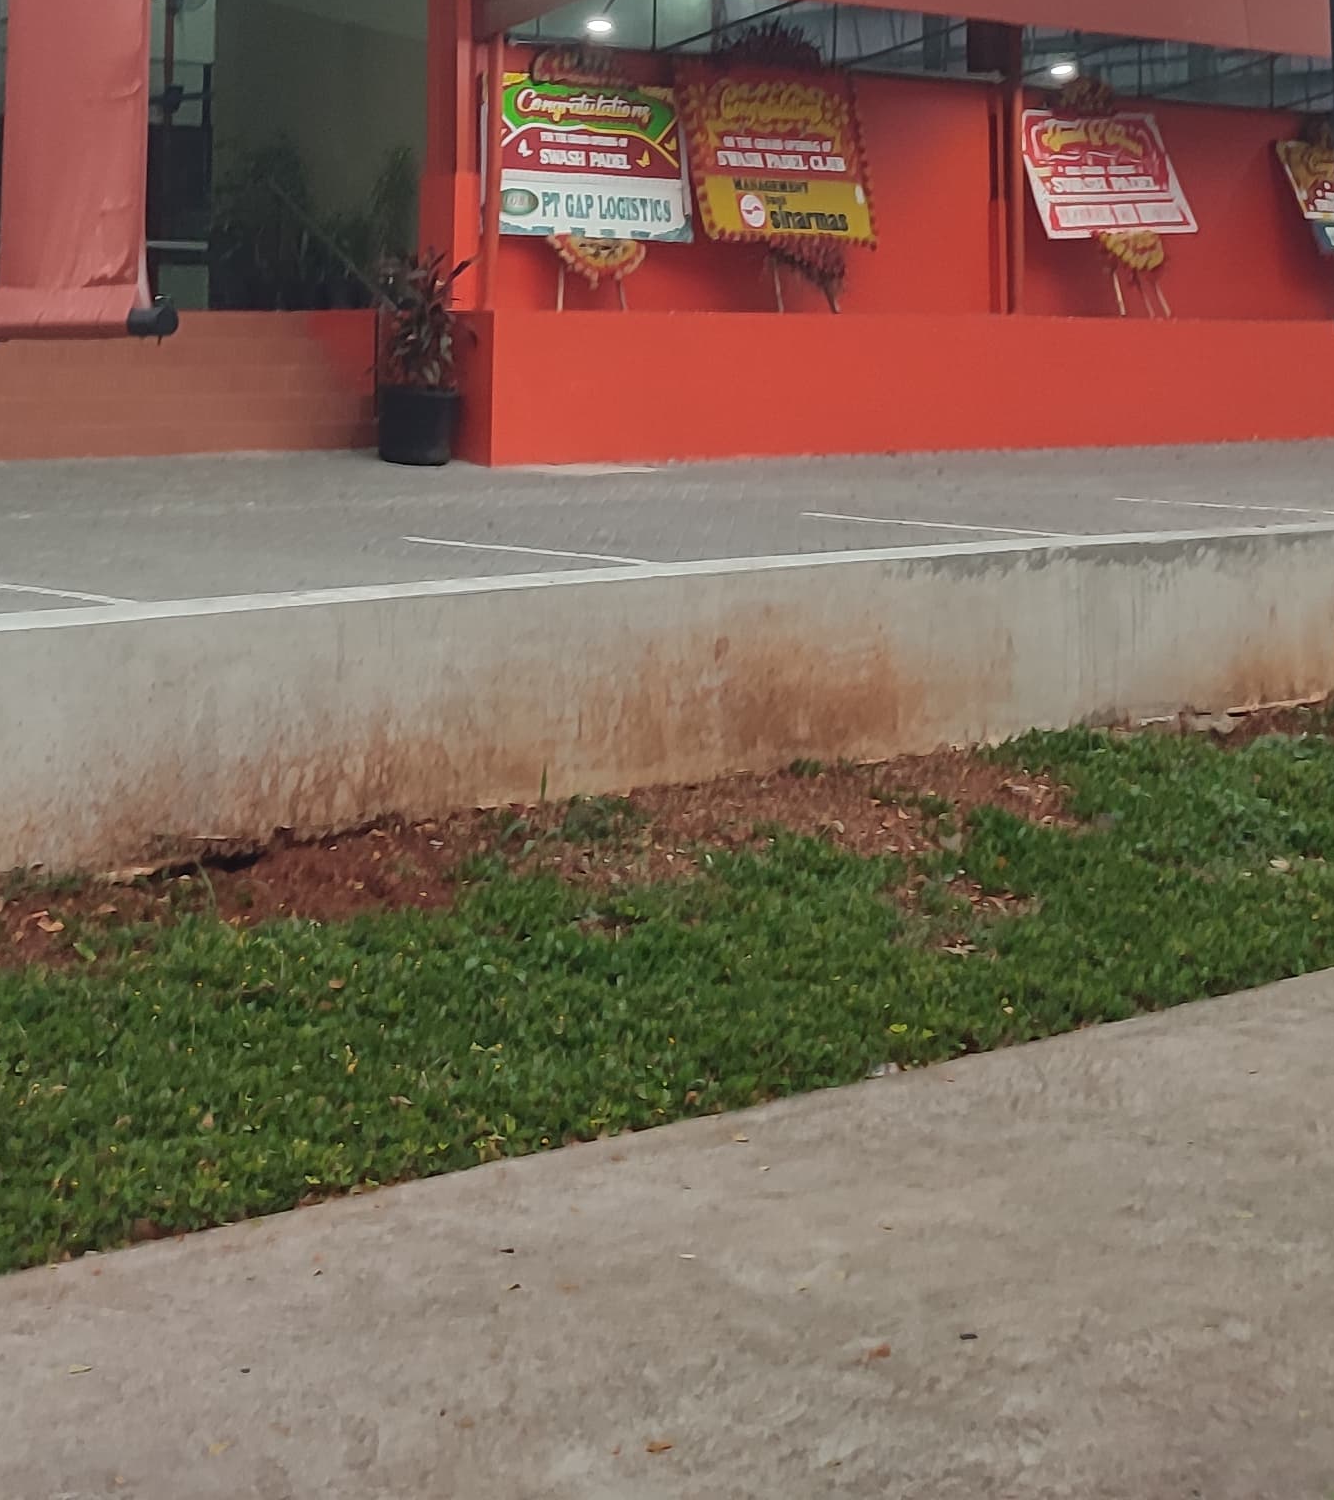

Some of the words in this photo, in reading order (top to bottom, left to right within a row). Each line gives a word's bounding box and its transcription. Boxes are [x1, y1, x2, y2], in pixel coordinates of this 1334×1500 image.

[516, 88, 652, 123] Congratulations
[541, 192, 561, 218] PT
[565, 194, 593, 219] GAP
[597, 194, 672, 223] LOGISTICS
